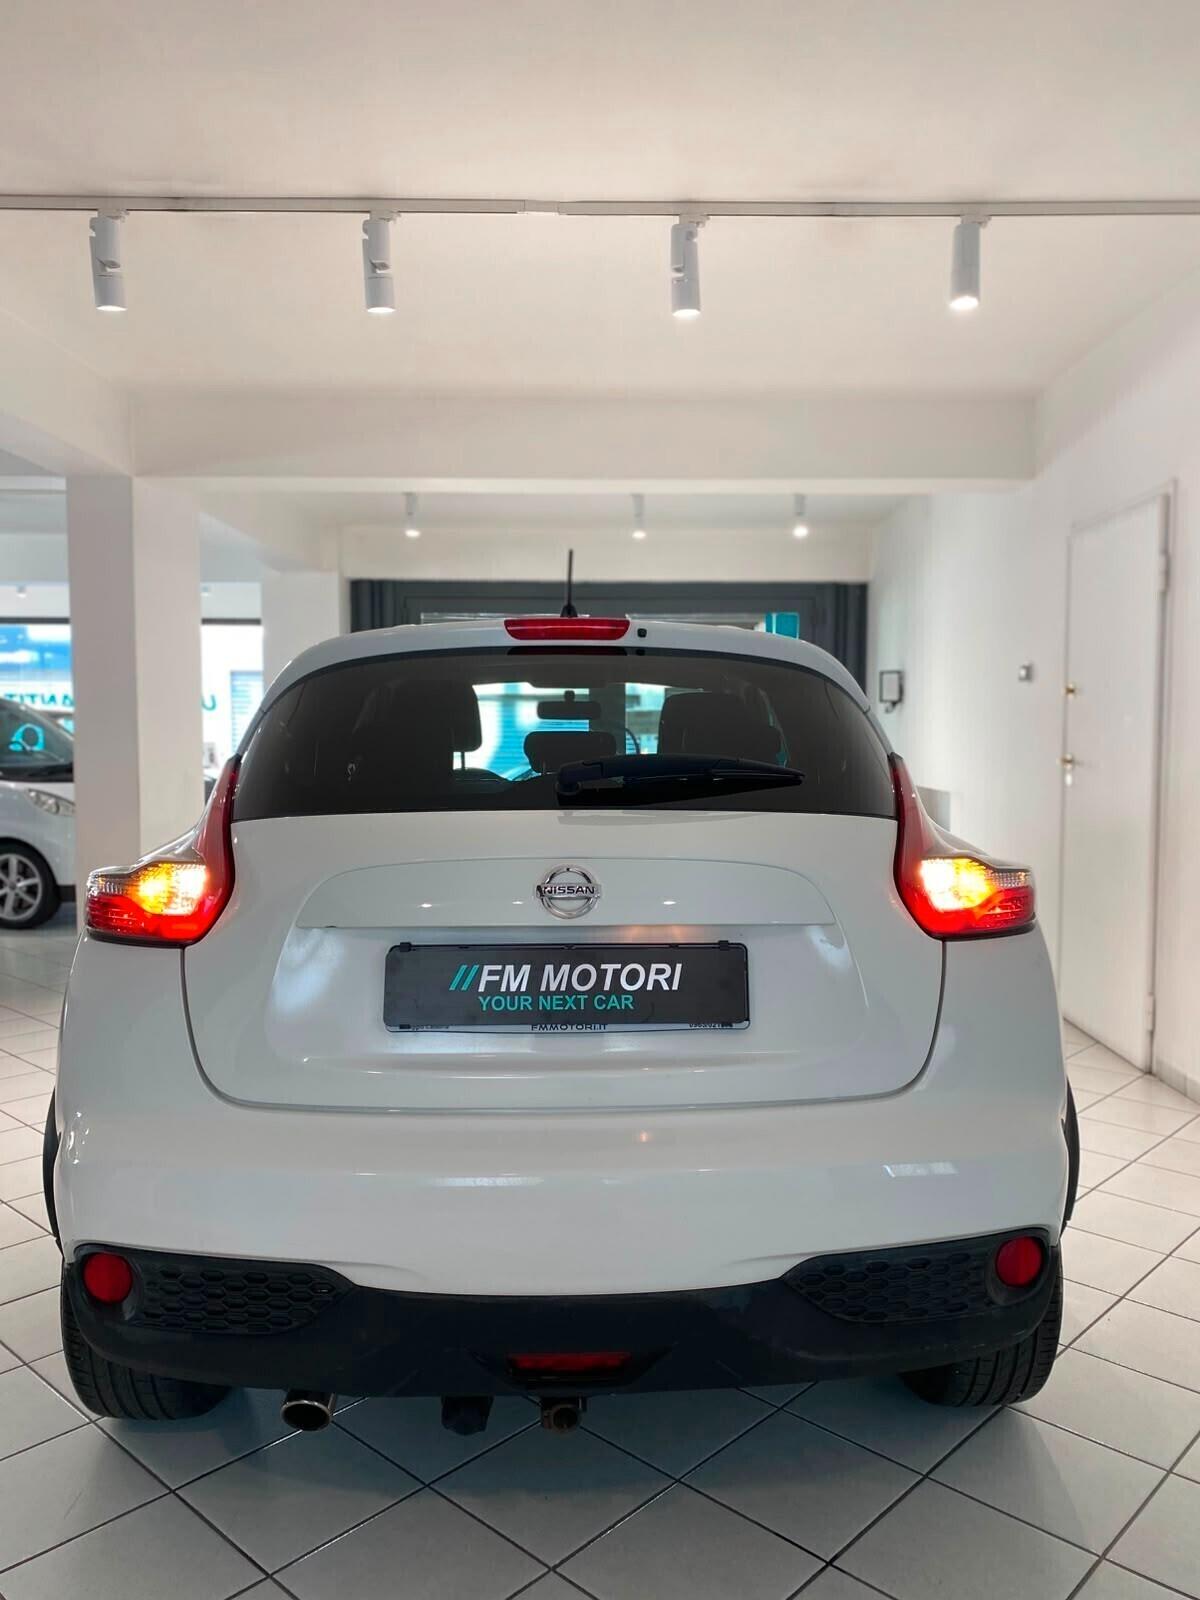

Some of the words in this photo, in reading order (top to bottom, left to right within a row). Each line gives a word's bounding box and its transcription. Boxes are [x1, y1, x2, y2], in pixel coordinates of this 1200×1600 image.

[543, 885, 595, 895] NISSAN
[540, 962, 682, 992] MOTORI
[478, 995, 532, 1011] YOUR
[538, 994, 588, 1011] NEXT
[593, 993, 634, 1010] CAR
